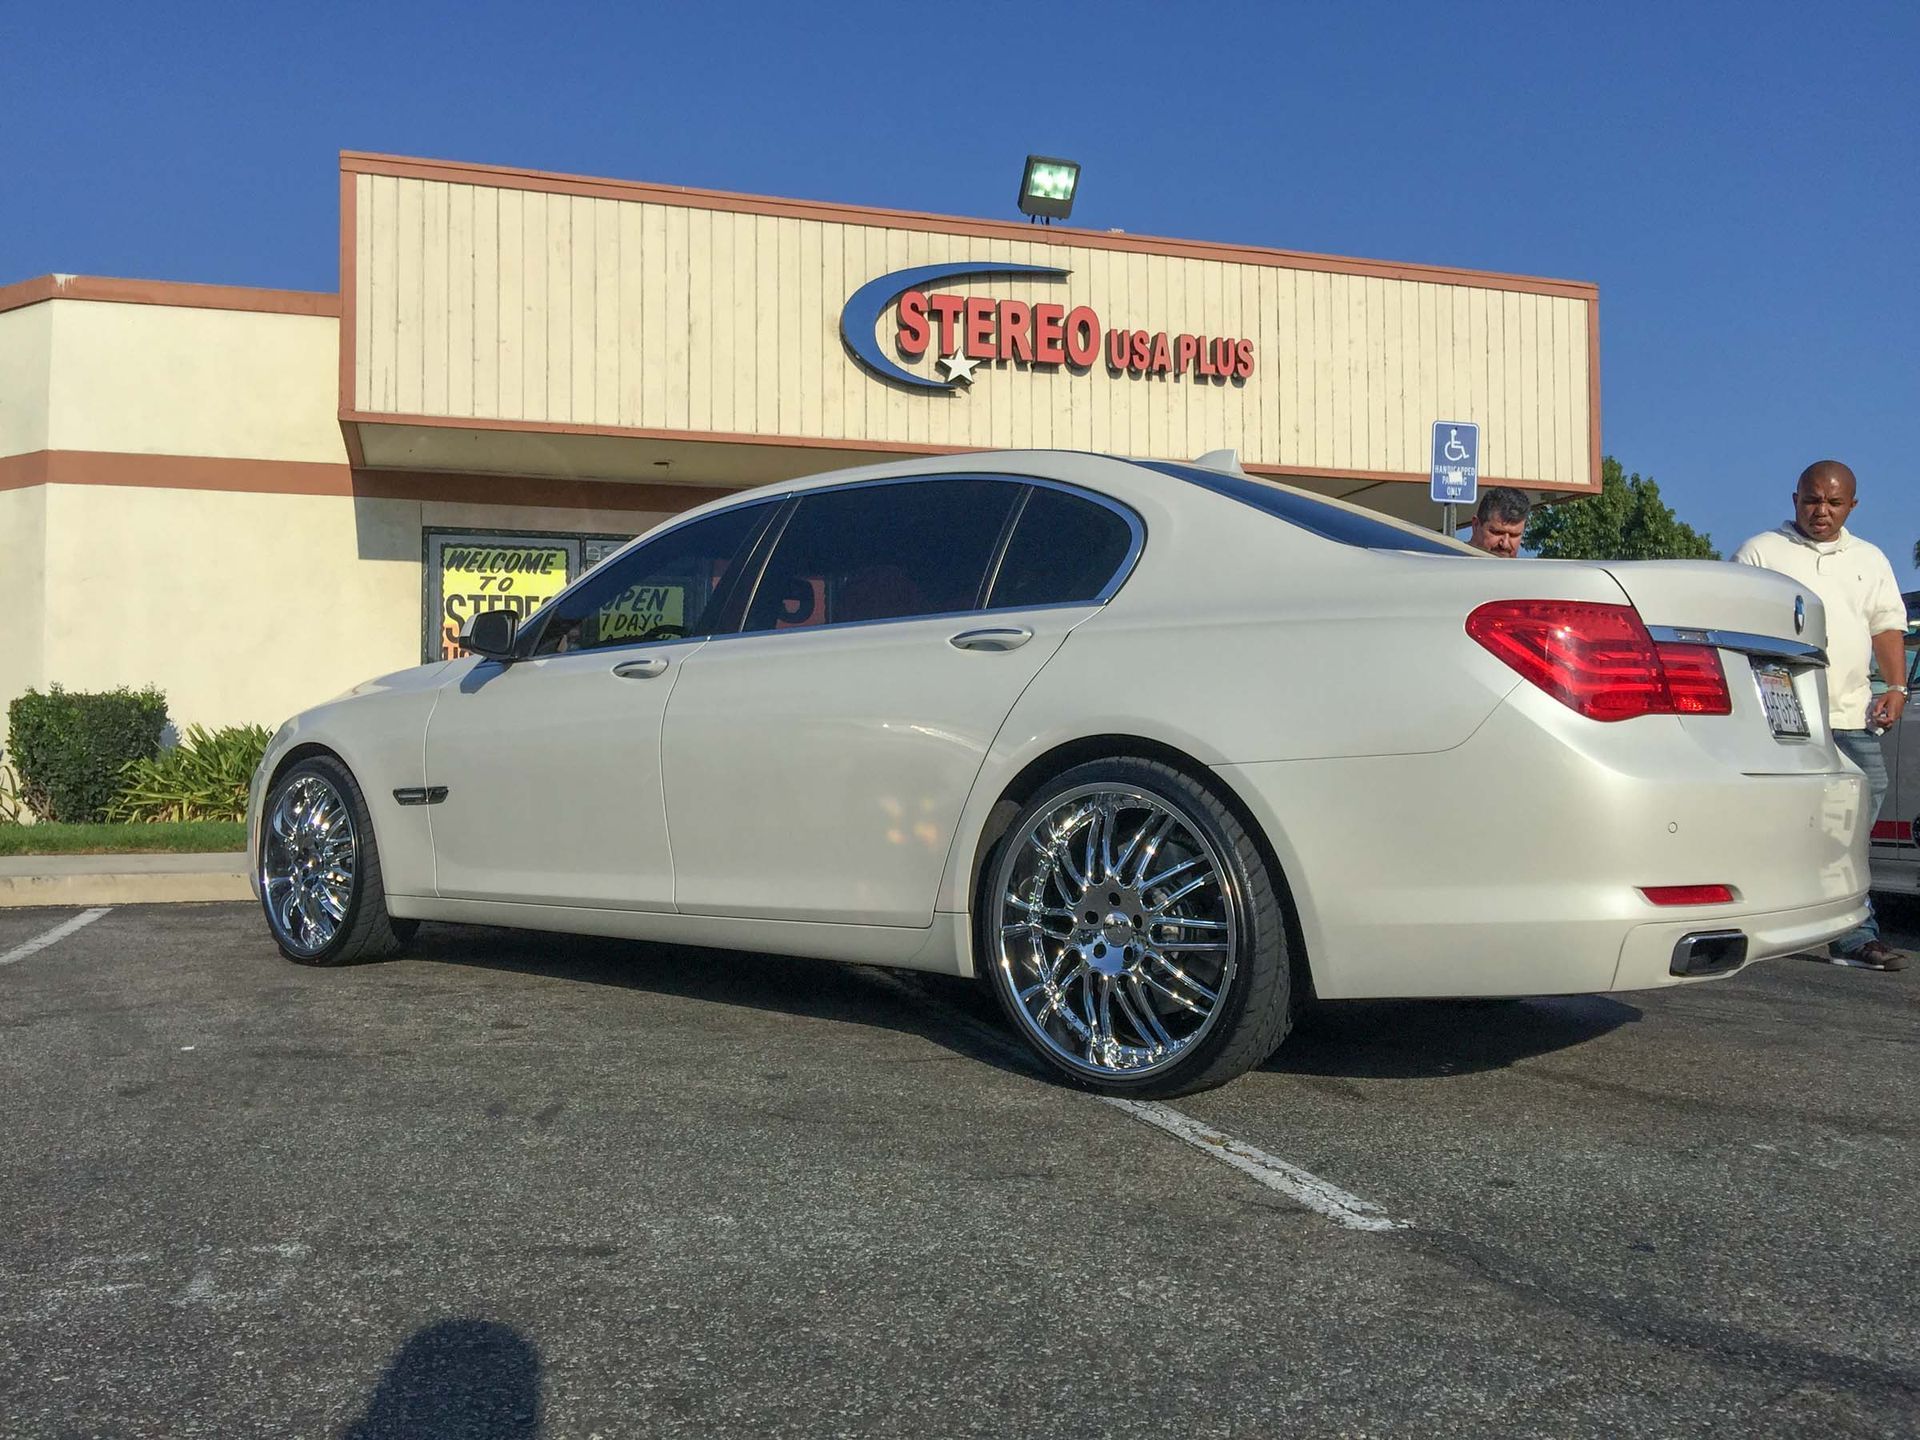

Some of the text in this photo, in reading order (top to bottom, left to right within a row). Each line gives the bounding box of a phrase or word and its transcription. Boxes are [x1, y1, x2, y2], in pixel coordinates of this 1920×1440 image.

[898, 290, 1255, 379] STEREO USA PLUS
[1446, 486, 1462, 496] ONLY
[446, 550, 557, 575] WELCOME
[480, 576, 514, 592] TO
[602, 613, 663, 632] 7 DAYS
